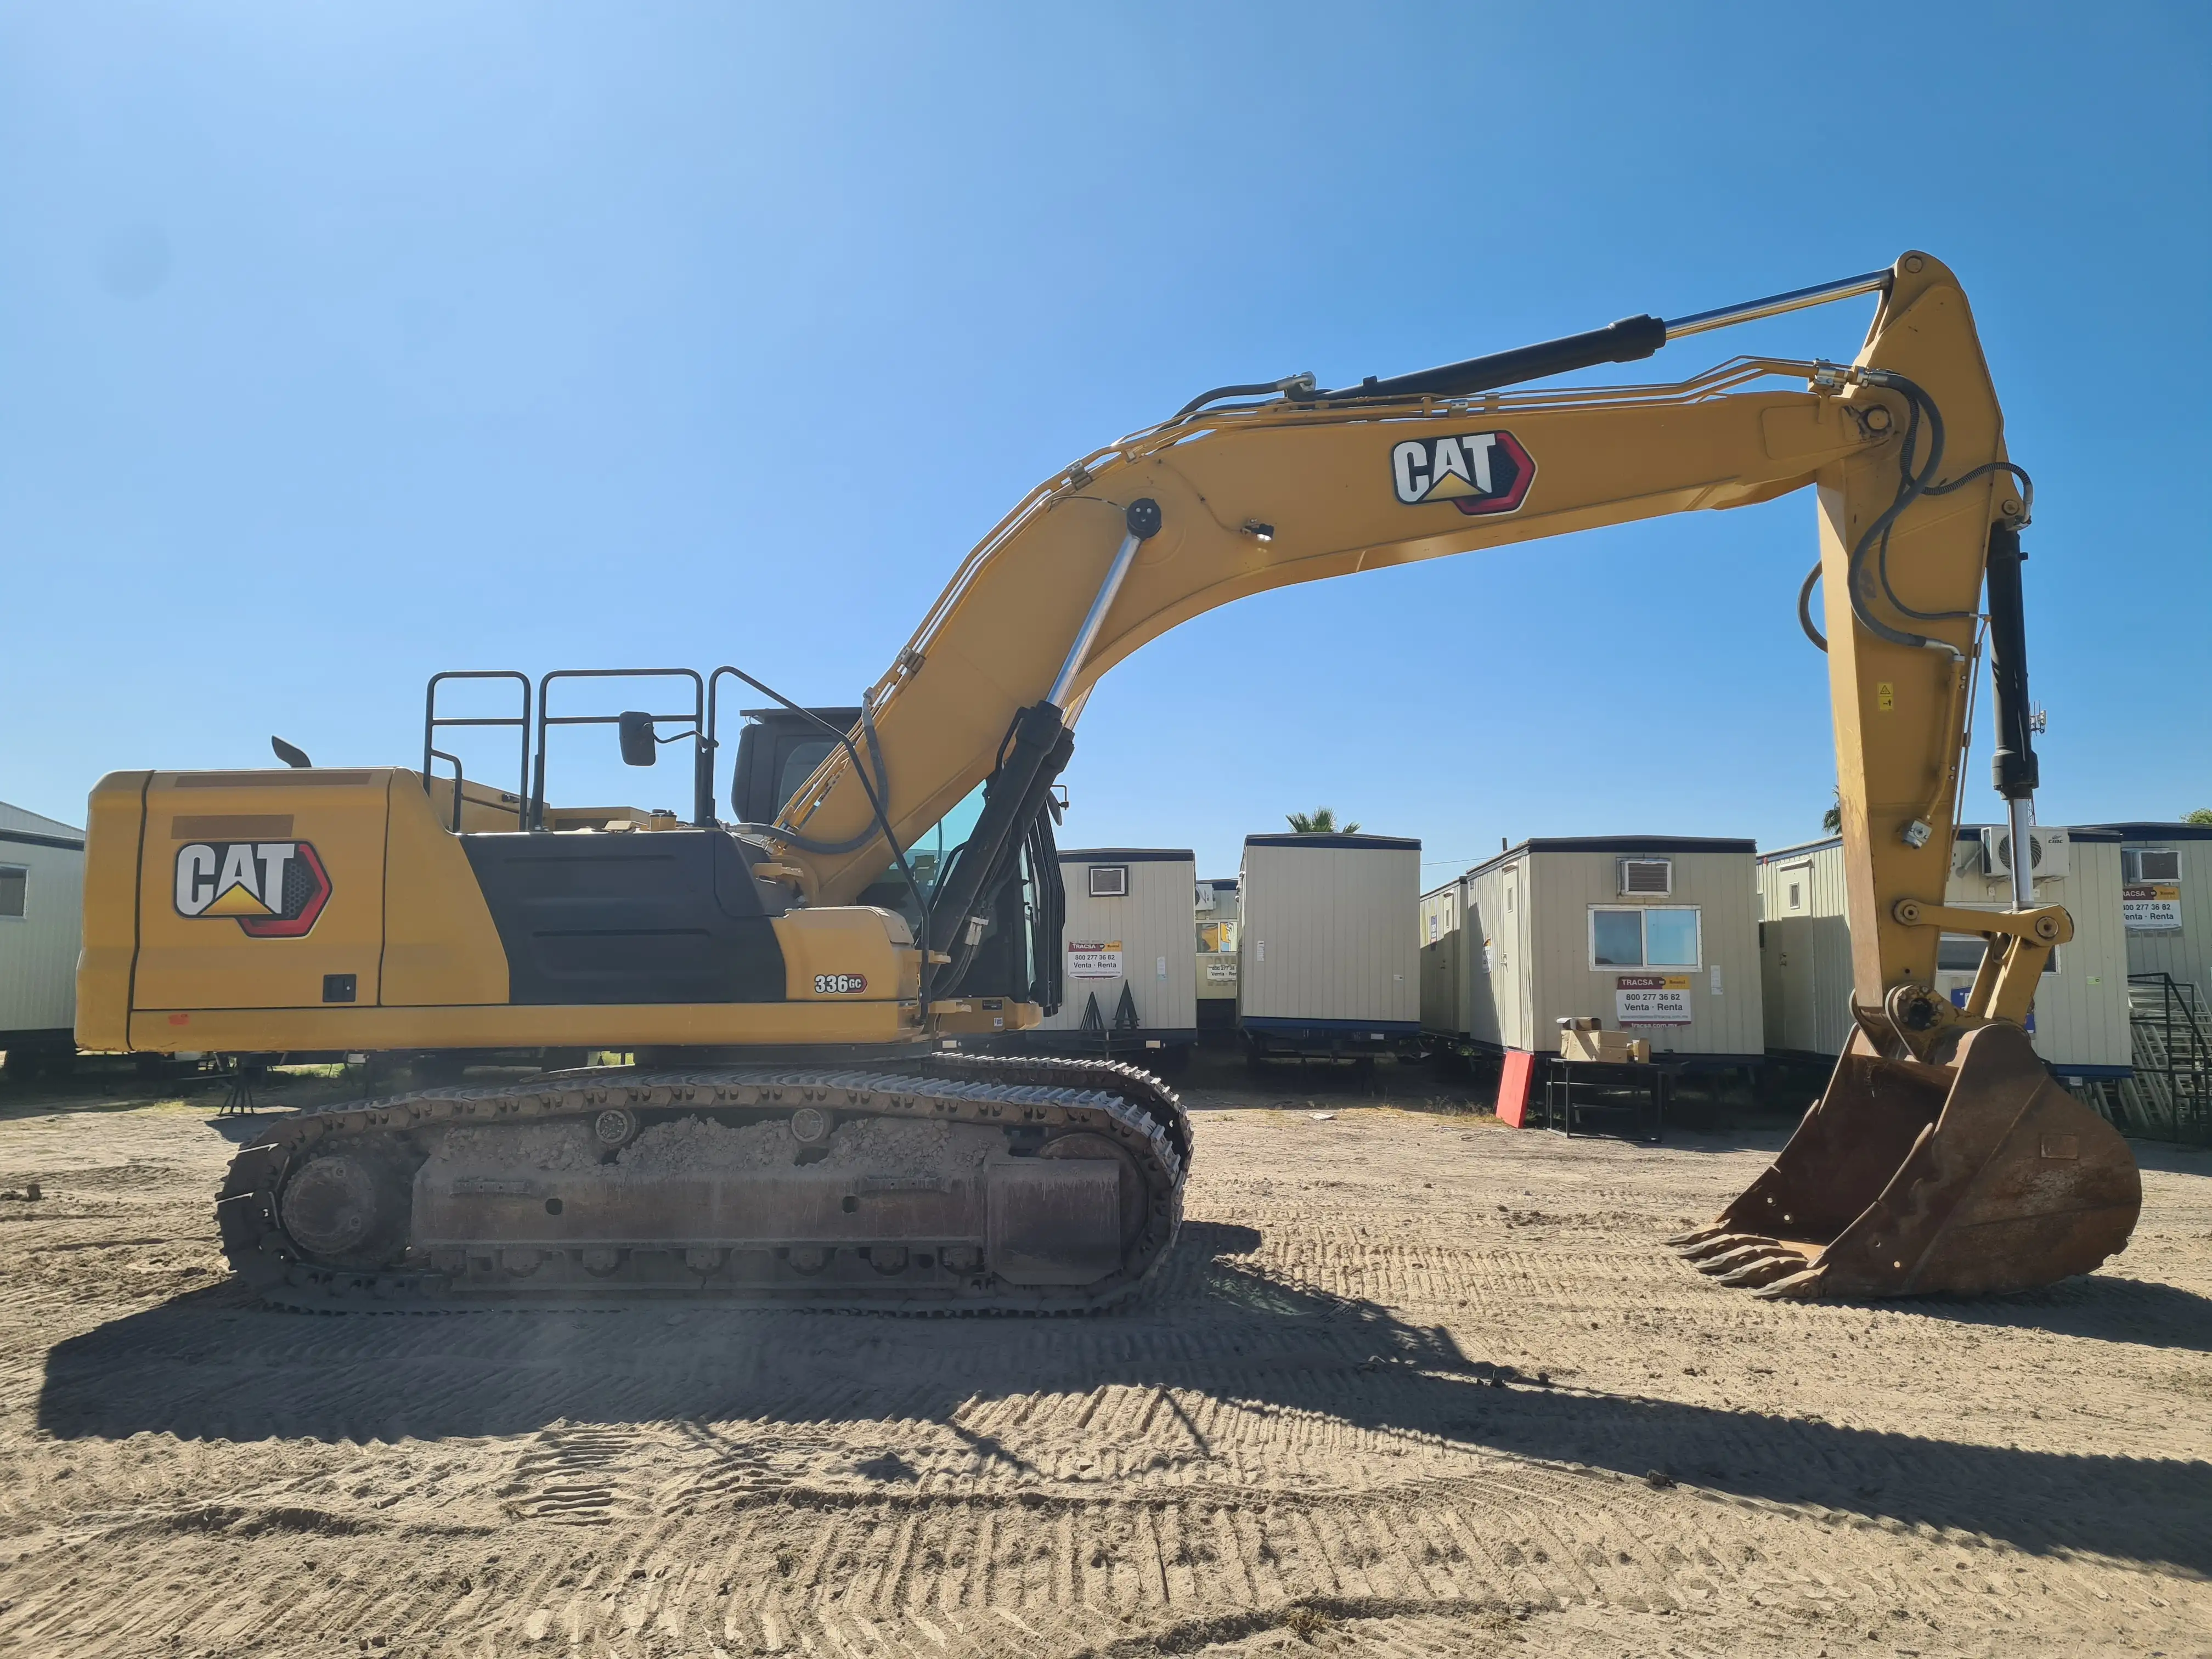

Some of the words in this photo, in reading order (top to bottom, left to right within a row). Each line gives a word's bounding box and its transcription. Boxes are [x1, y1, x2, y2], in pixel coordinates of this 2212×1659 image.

[1393, 433, 1496, 502] CAT
[177, 843, 295, 916] CAT
[815, 975, 848, 992] 336
[849, 979, 861, 988] GC
